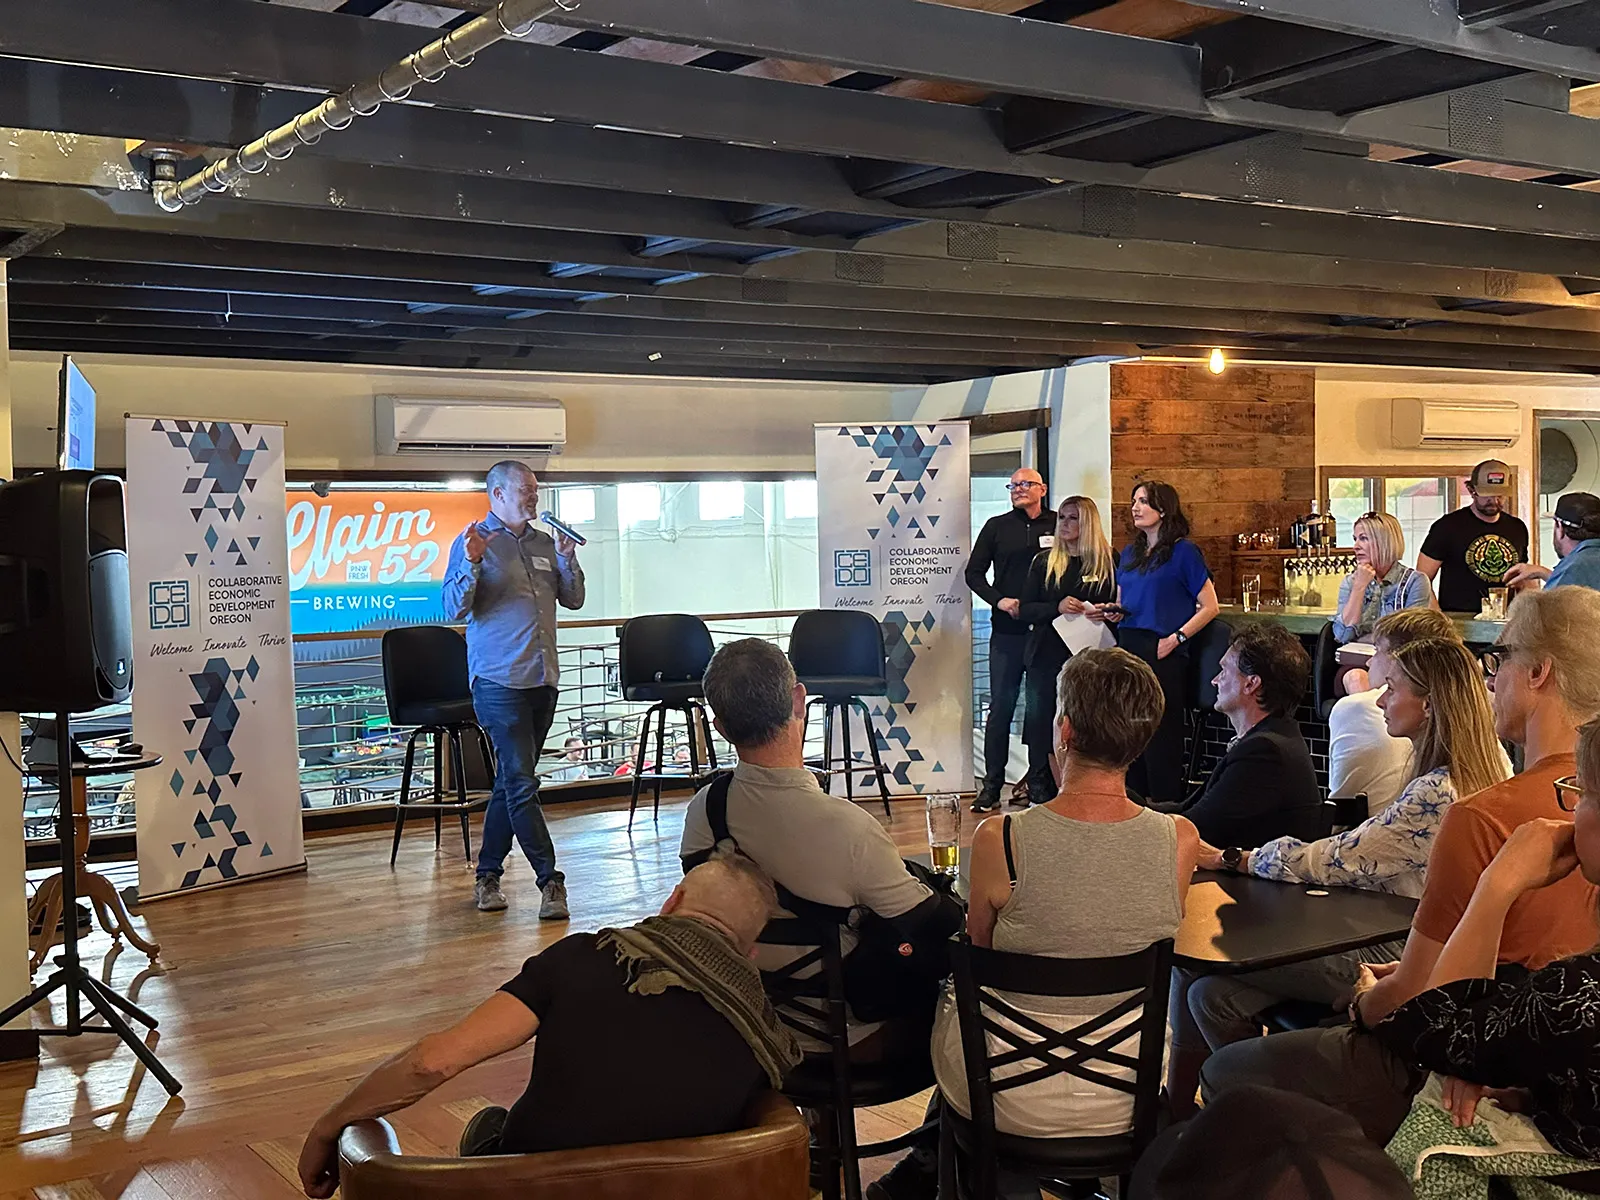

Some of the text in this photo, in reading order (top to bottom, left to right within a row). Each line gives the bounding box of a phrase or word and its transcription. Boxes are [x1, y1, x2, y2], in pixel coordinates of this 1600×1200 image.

[286, 501, 436, 592] Claim
[889, 547, 961, 557] COLLABORATIVE
[377, 540, 440, 585] 52
[889, 557, 939, 567] ECONOMIC
[350, 565, 368, 573] PNW
[889, 566, 953, 576] DEVELOPMENT
[208, 575, 283, 588] COLLABORATIVE
[348, 572, 369, 580] FRESH
[889, 577, 929, 586] OREGON
[208, 588, 261, 600] ECONOMIC
[209, 600, 276, 613] DEVELOPMENT
[313, 594, 396, 611] BREWING
[834, 593, 963, 608] Welcome Innovate Thrive
[209, 613, 252, 625] OREGON
[150, 632, 287, 658] Welcome Innovate Thrive
